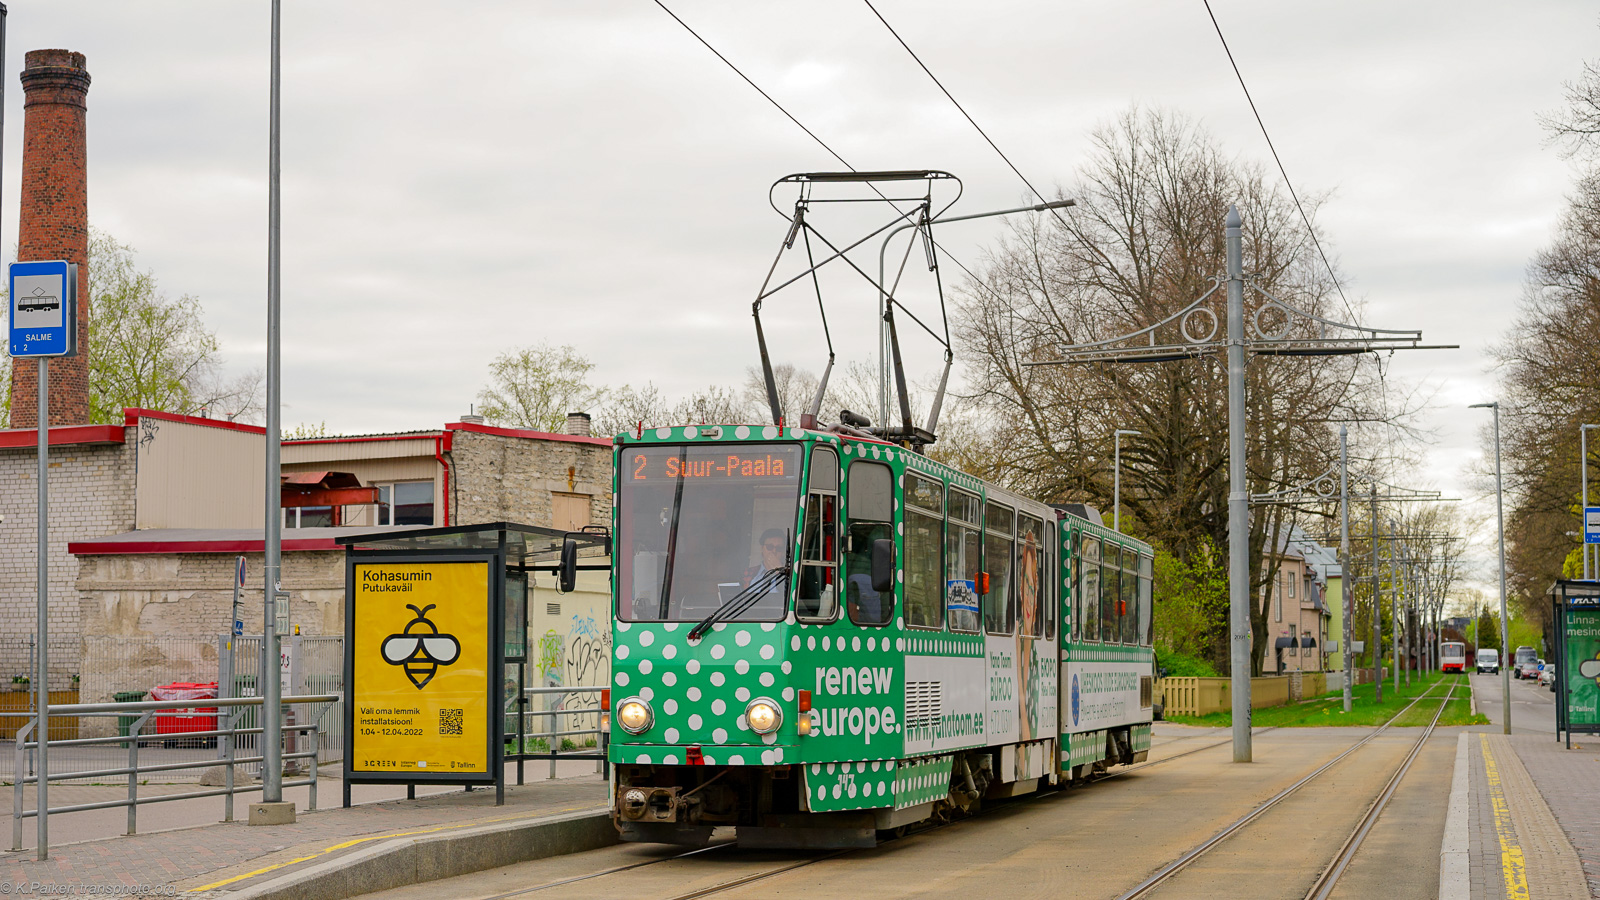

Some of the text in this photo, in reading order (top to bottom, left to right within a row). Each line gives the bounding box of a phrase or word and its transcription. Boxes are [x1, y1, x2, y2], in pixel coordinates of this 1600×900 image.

[26, 333, 52, 342] SALME
[634, 454, 784, 480] 2 Suur-Paala
[363, 570, 432, 582] Kohasumin
[362, 583, 412, 592] Putukaväil
[1567, 616, 1599, 624] Linna-
[816, 666, 893, 696] renew
[990, 671, 1012, 701] BÜROO
[807, 706, 901, 745] europe.
[906, 709, 984, 748] www.yanatoom.ee
[838, 774, 855, 791] 147
